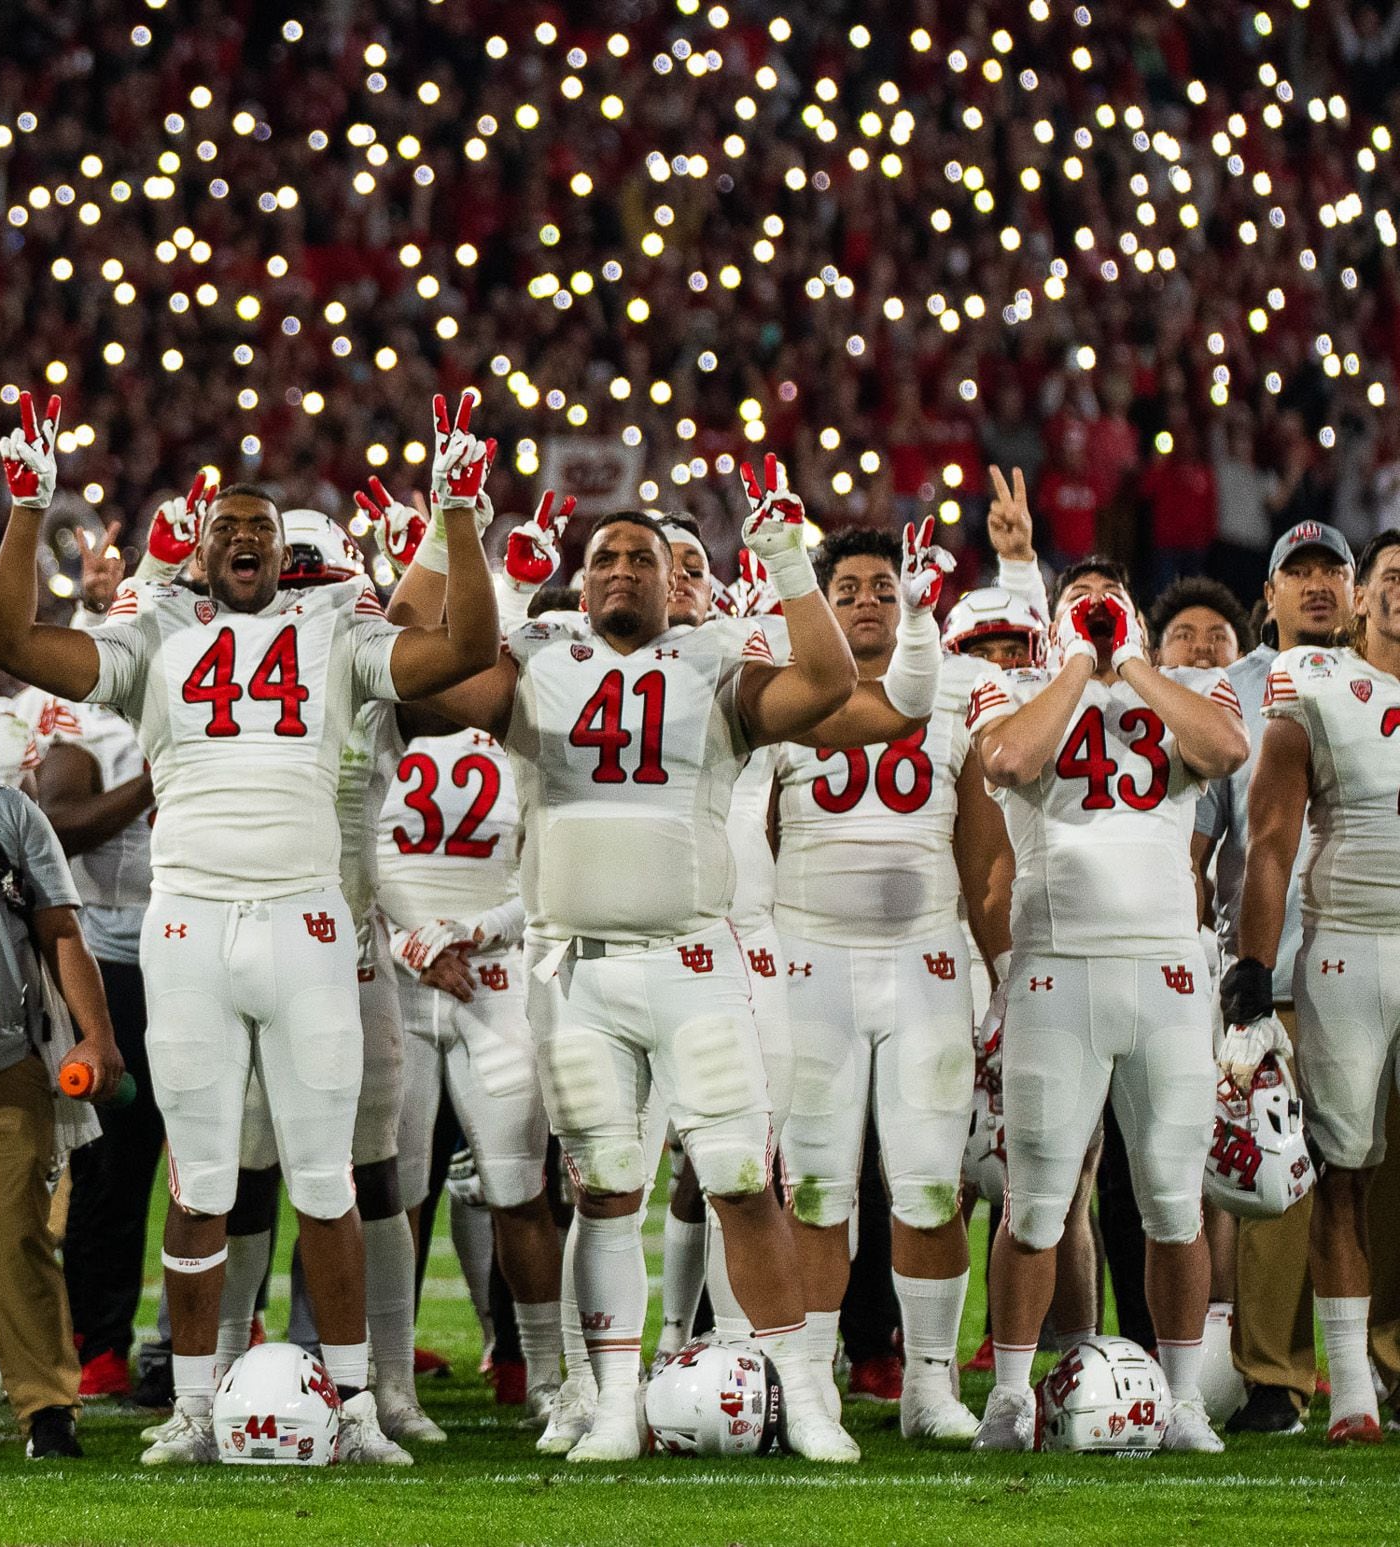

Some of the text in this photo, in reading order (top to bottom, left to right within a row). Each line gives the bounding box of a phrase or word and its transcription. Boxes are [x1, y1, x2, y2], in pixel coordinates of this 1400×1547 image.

[182, 625, 310, 738] 44
[568, 668, 669, 785] 41
[1055, 704, 1171, 812] 43
[392, 752, 501, 858] 32
[177, 1257, 202, 1267] UTAH
[244, 1414, 278, 1440] 44
[768, 1384, 780, 1424] UTES
[1126, 1401, 1156, 1426] 43
